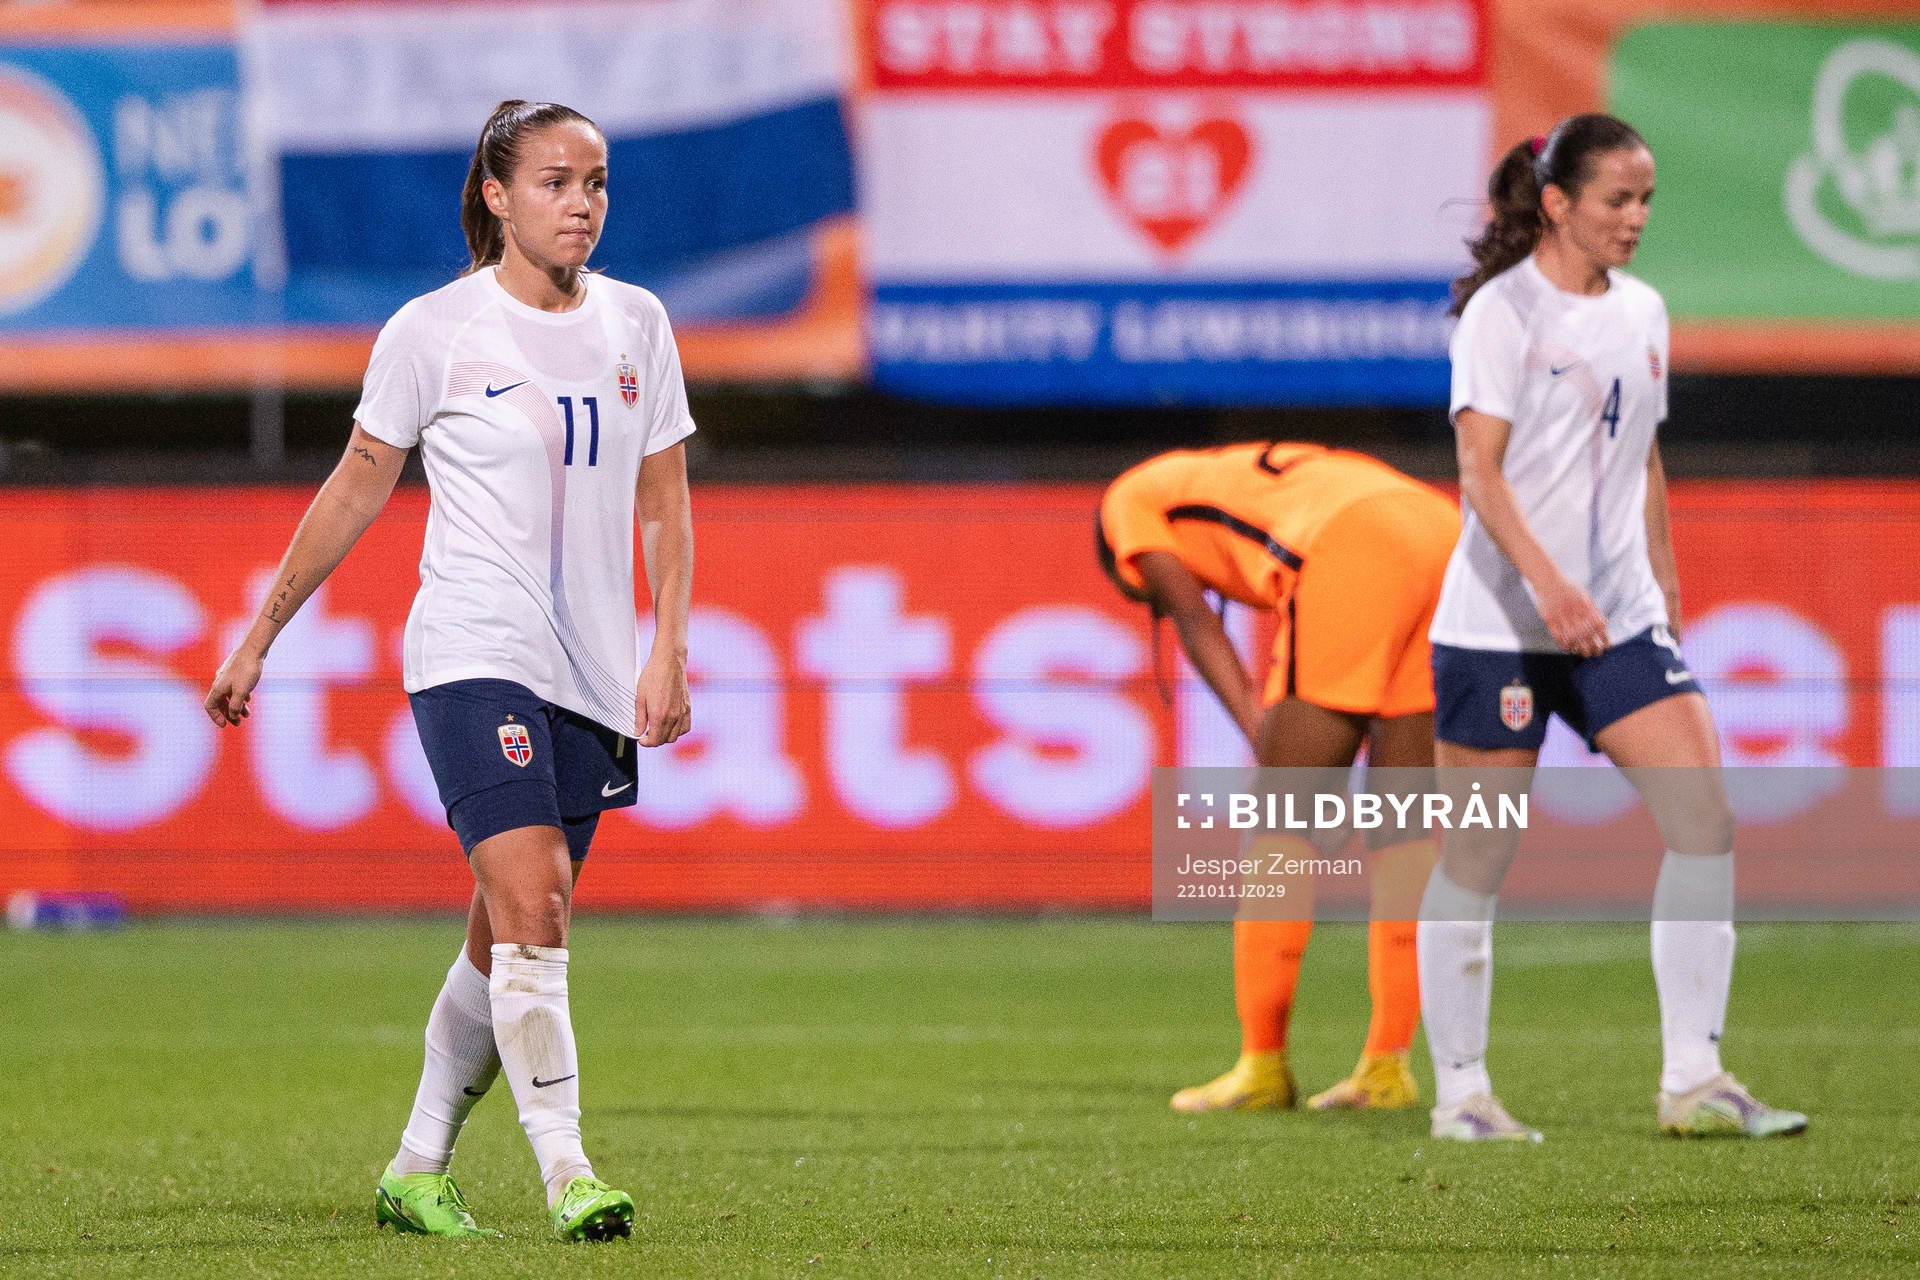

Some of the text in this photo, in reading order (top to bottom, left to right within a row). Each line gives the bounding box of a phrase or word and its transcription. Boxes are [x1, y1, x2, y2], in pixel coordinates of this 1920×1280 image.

[880, 7, 1478, 71] STAY STRONG
[557, 396, 599, 467] 11
[1602, 376, 1621, 438] 4
